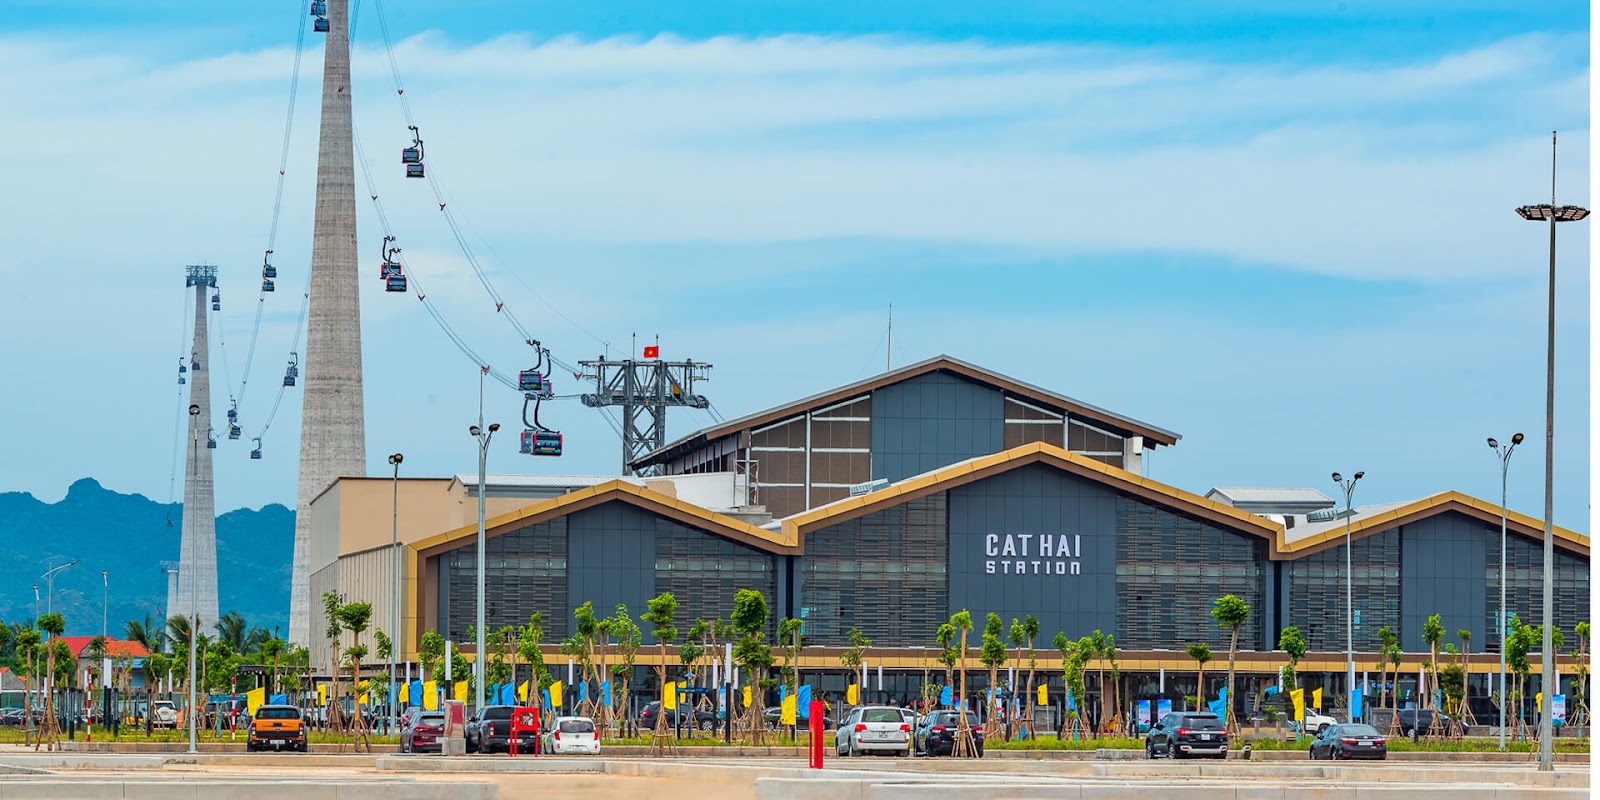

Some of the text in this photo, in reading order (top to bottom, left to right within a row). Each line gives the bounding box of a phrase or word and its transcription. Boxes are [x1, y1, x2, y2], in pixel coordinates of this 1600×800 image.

[986, 533, 1081, 557] CAT HAI
[985, 560, 1081, 575] STATION
